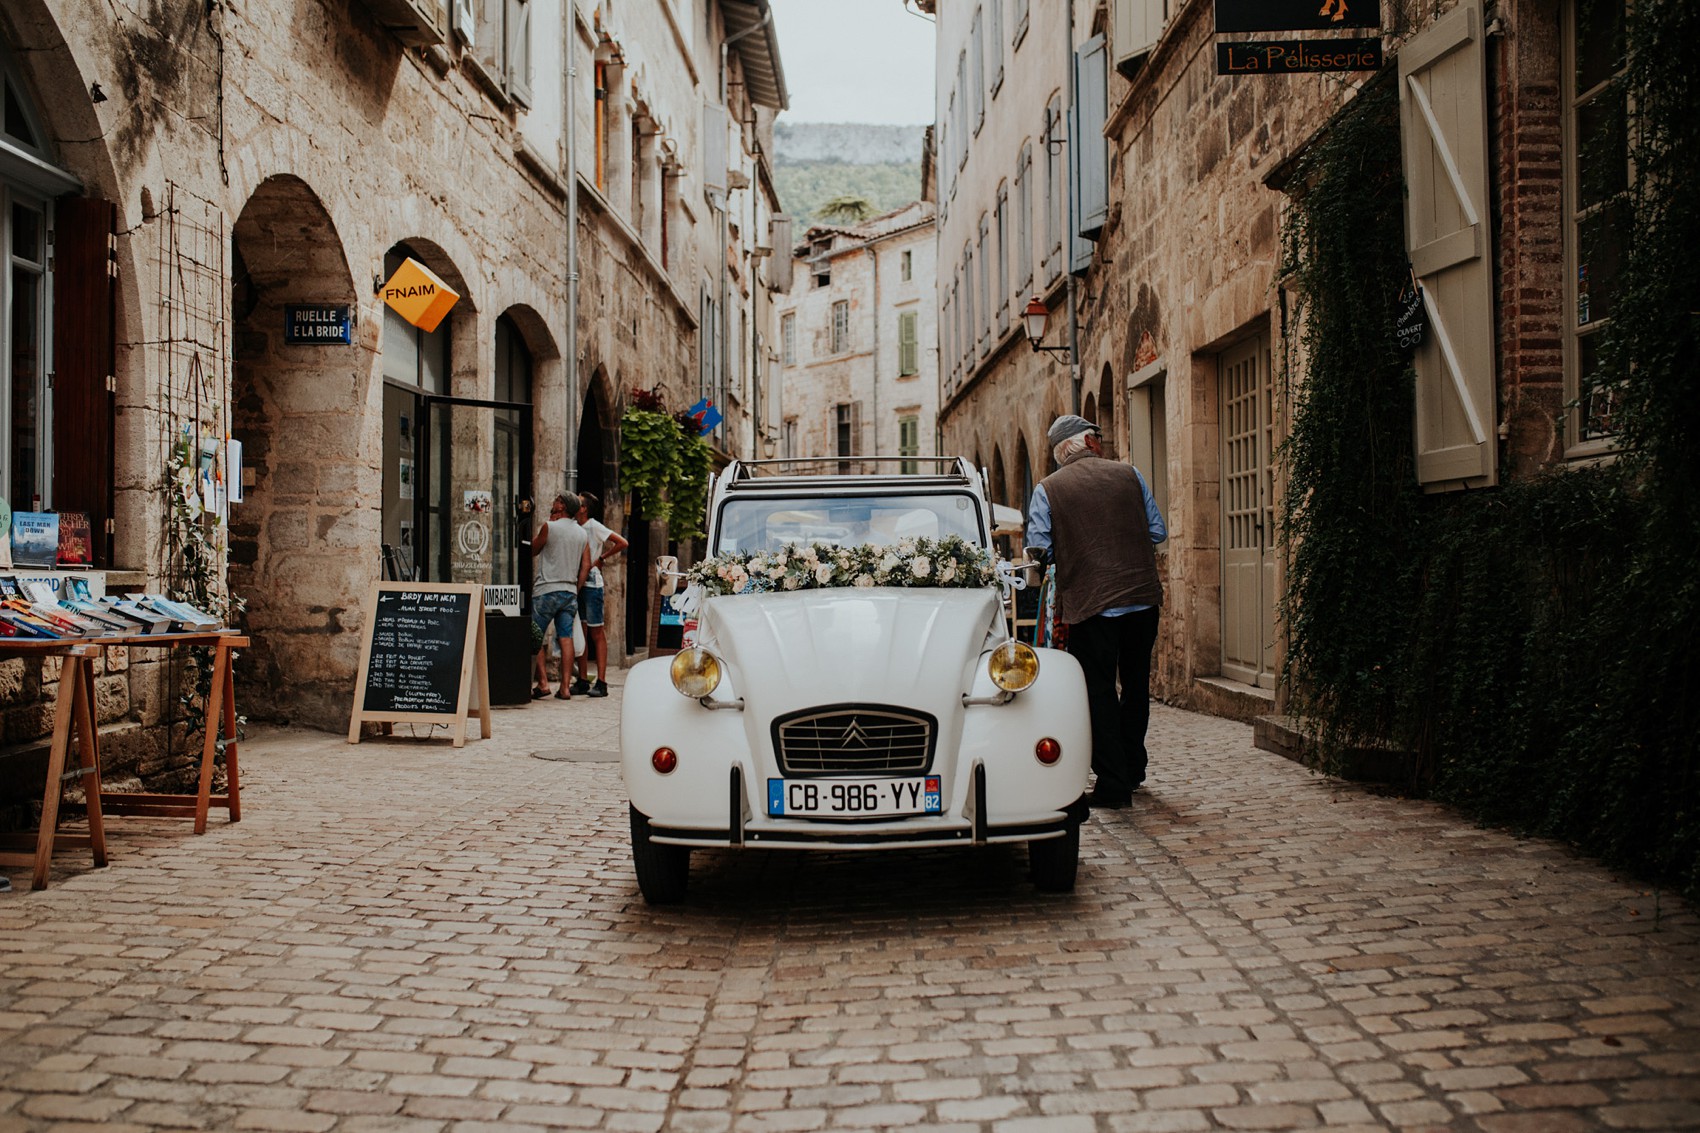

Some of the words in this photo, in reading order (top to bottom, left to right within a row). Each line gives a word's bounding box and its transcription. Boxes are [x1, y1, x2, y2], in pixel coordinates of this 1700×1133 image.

[1228, 47, 1259, 70] La
[1267, 43, 1375, 69] Pélisserie
[386, 284, 435, 300] FNAIM
[295, 310, 337, 322] RUELLE
[302, 325, 314, 337] LA
[316, 325, 345, 338] BRIDE
[1397, 323, 1423, 338] OUVERT
[400, 592, 422, 604] BIRDY
[424, 593, 439, 602] NEM
[440, 594, 456, 603] NEM
[789, 782, 921, 811] CB-986-YY
[925, 795, 940, 809] 82
[773, 800, 780, 809] F
